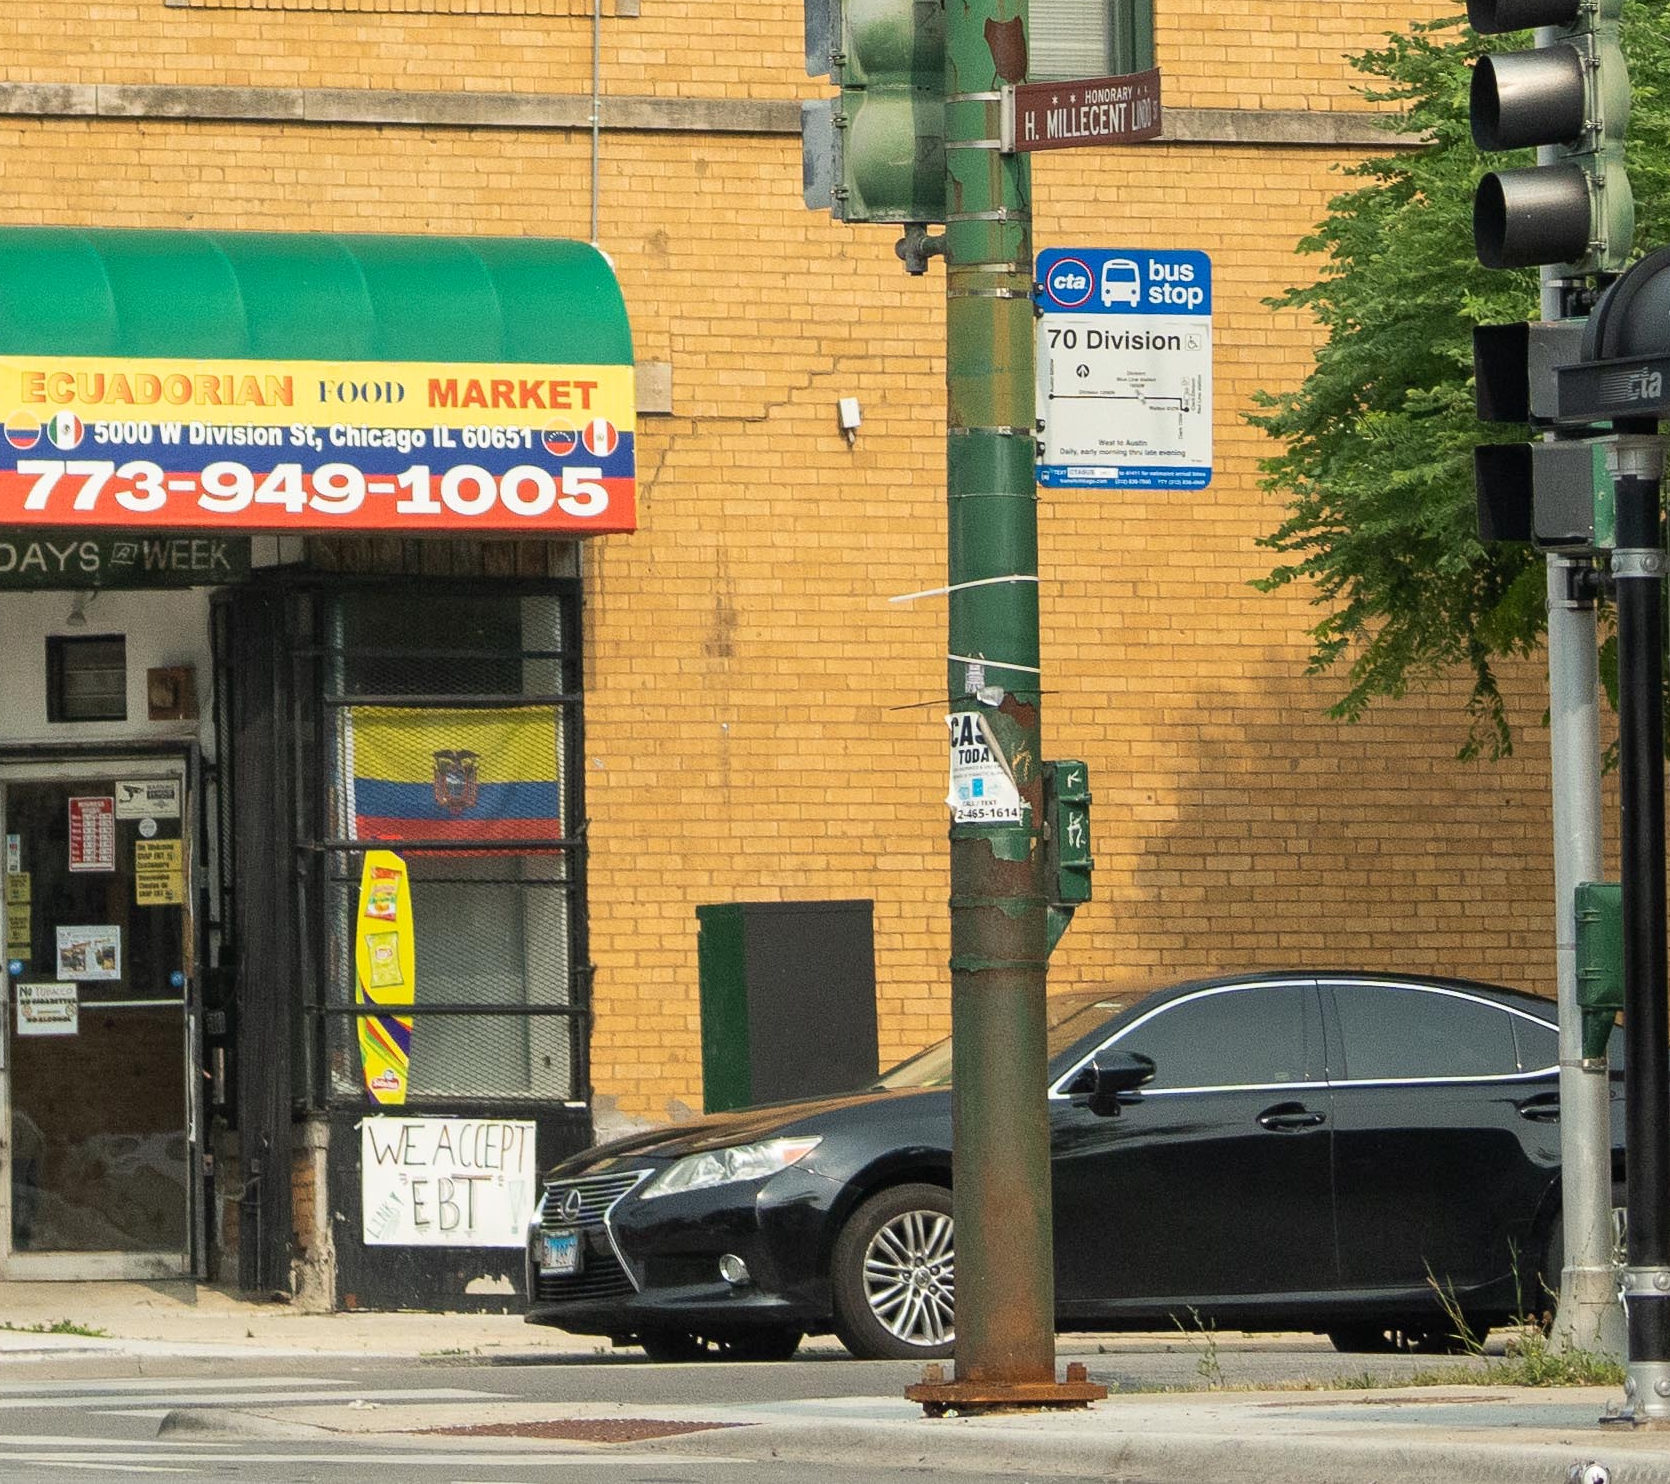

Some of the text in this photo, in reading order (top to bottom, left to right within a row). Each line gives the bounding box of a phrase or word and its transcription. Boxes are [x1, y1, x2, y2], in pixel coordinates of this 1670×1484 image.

[1084, 86, 1133, 104] HONORARY
[1025, 110, 1040, 141] H.
[1046, 103, 1127, 139] MILLECENT
[1053, 273, 1086, 290] cta
[1149, 259, 1195, 281] bus
[1148, 283, 1204, 310] stop
[1047, 329, 1181, 351] 70 Division
[20, 371, 598, 410] ECUADORIAN FOOD MARKET
[93, 421, 533, 454] 5000 W Division St, Chicago IL 60651
[1060, 448, 1079, 456] Daily,
[1080, 449, 1097, 457] early
[1099, 449, 1128, 457] morning
[1158, 450, 1186, 458] evening
[16, 459, 610, 517] 773-949-1005
[142, 539, 230, 571] WEEK
[950, 715, 988, 748] CAS
[958, 748, 999, 765] TODA
[957, 807, 1018, 820] 2-465-1614
[368, 1123, 534, 1173] WE ACCEPT
[411, 1174, 493, 1231] EBT
